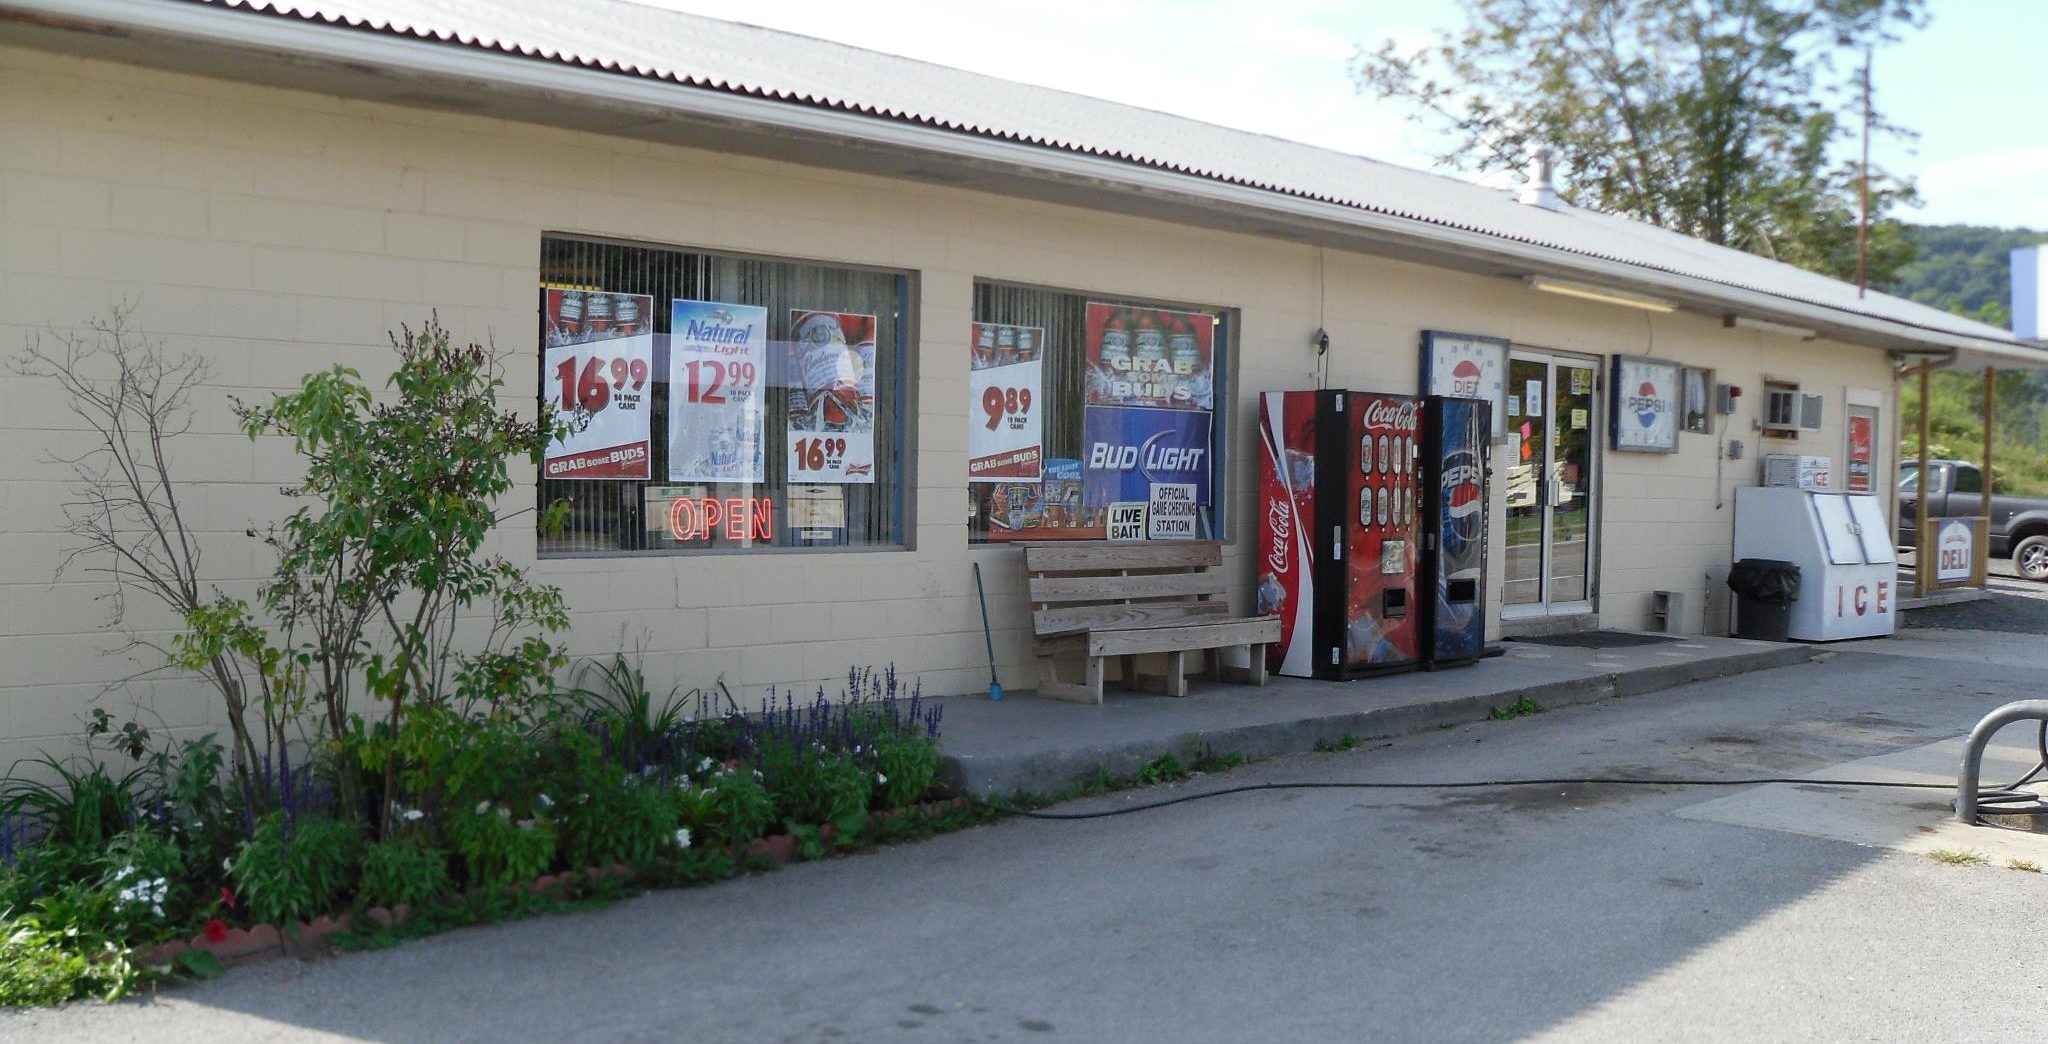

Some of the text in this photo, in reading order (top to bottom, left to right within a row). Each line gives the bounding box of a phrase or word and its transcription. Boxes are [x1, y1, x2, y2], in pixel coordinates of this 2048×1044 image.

[686, 319, 752, 345] Natural
[1111, 355, 1192, 374] GRAB
[1112, 381, 1191, 400] BUDS
[1454, 381, 1479, 394] DIET
[618, 402, 636, 410] CANS
[624, 394, 640, 402] PACK
[1628, 396, 1666, 413] PEPSI
[549, 458, 586, 474] GRAB
[611, 447, 645, 463] BUDS
[970, 459, 997, 472] GRAB
[1013, 450, 1038, 464] BUDS
[1090, 442, 1204, 471] BUD LIGHT
[1158, 487, 1190, 501] OFFICIAL
[1111, 509, 1142, 523] LIVE
[1152, 501, 1196, 517] GAME CHECKING
[670, 497, 773, 541] OPEN
[1155, 520, 1190, 533] STATION
[1111, 525, 1141, 539] BAIT
[1941, 549, 1969, 570] DELI
[1837, 581, 1888, 618] ICE
